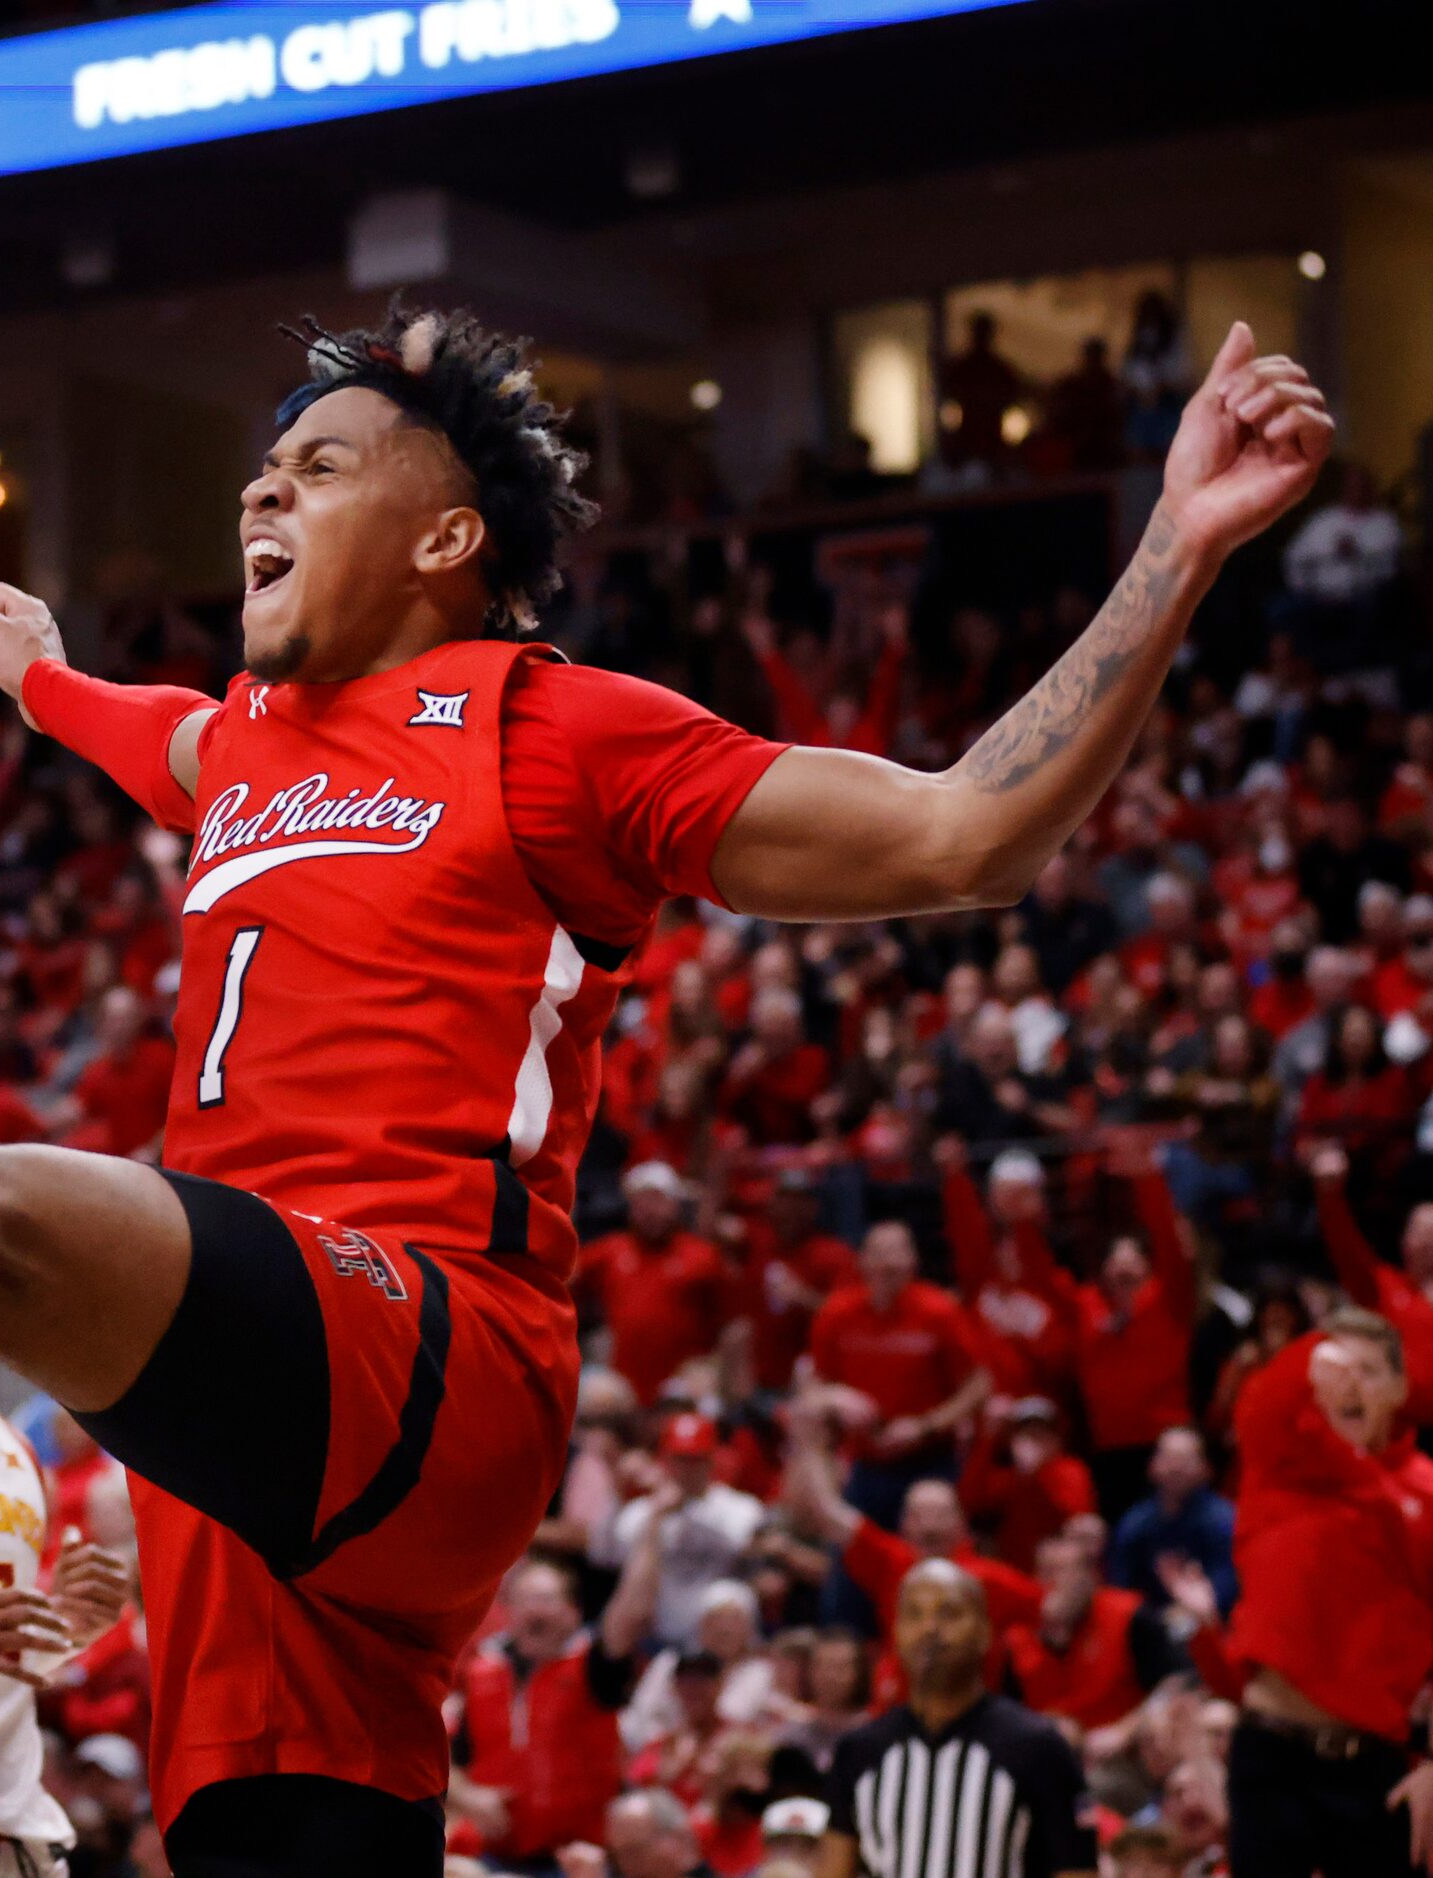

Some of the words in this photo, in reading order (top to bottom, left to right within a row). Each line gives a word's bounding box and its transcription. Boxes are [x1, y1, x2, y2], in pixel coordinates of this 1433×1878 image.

[73, 35, 277, 128] FRESH
[281, 11, 414, 91] CUT
[187, 781, 286, 874] Red
[259, 772, 446, 846] Raiders
[198, 926, 264, 1109] 1
